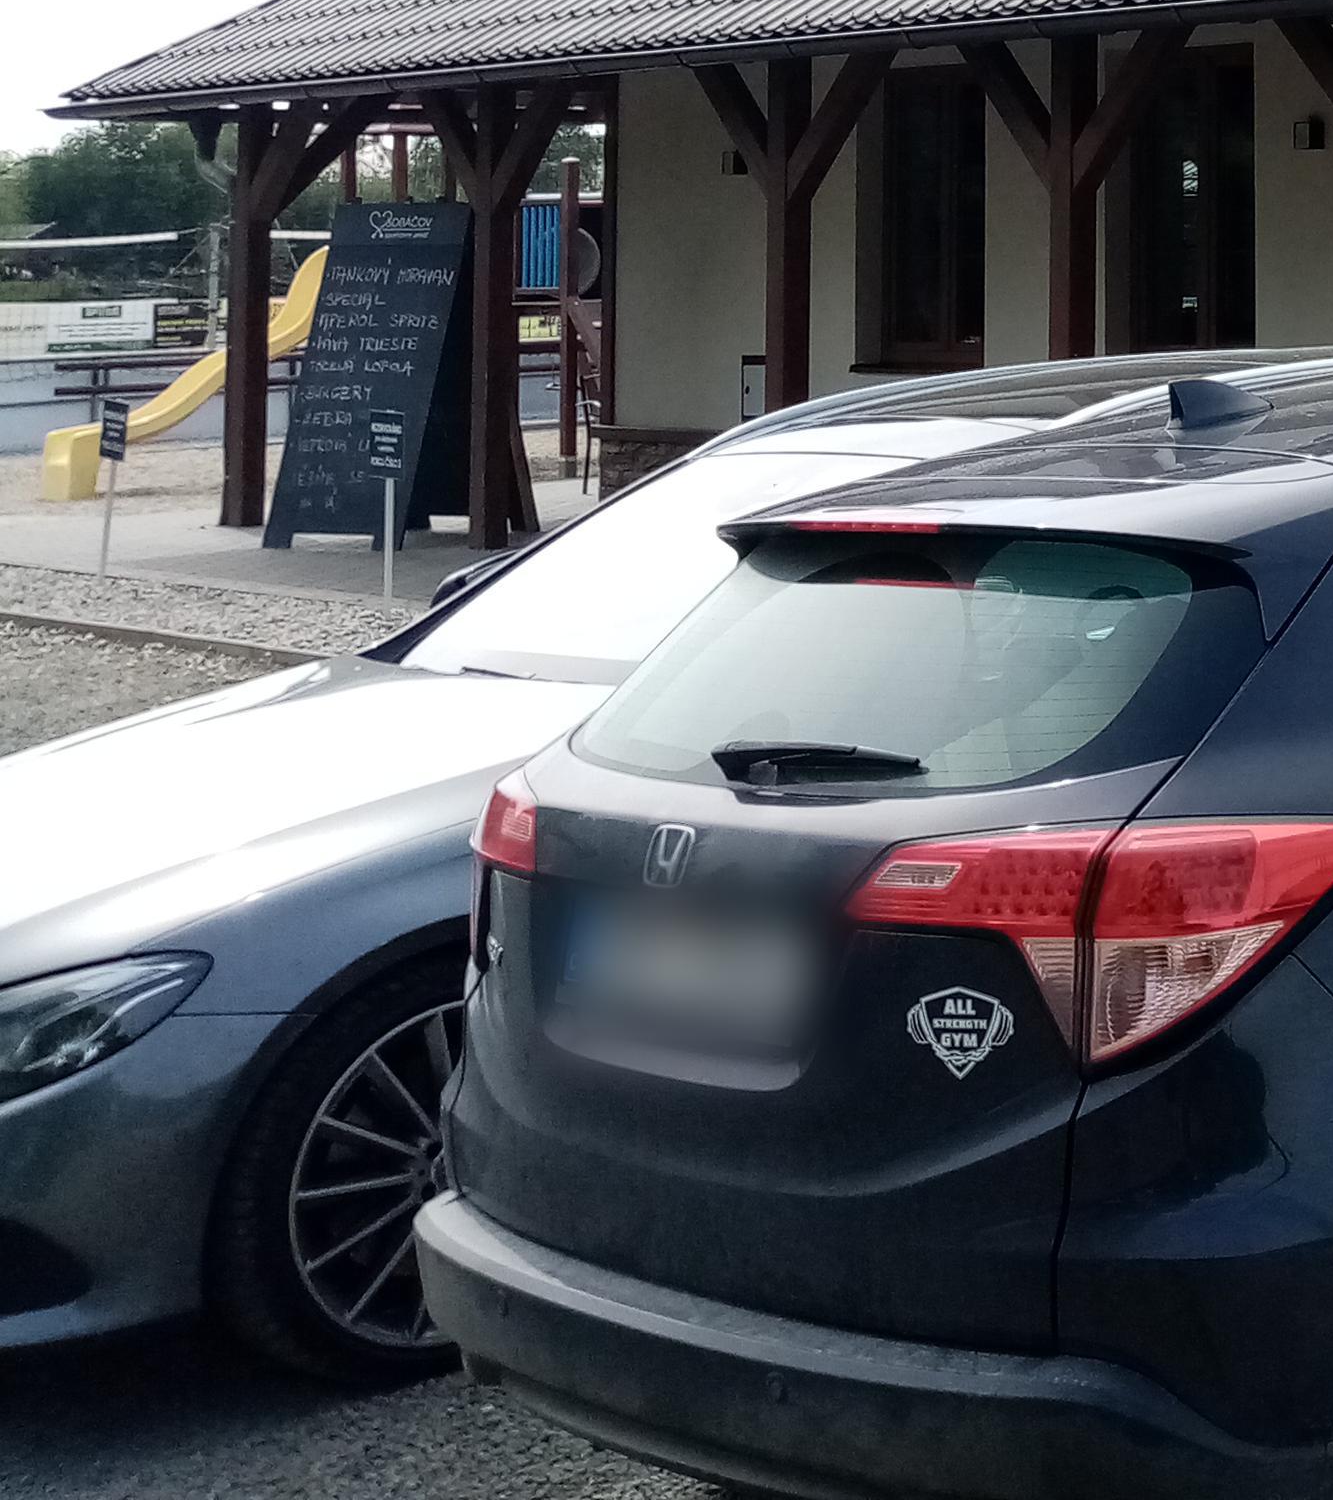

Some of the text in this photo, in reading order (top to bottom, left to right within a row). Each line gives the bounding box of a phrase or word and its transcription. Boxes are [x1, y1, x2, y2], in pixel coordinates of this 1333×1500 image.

[318, 312, 379, 332] APEROL
[943, 998, 976, 1016] ALL
[932, 1018, 988, 1030] STRENGTH
[940, 1033, 978, 1048] GYM
